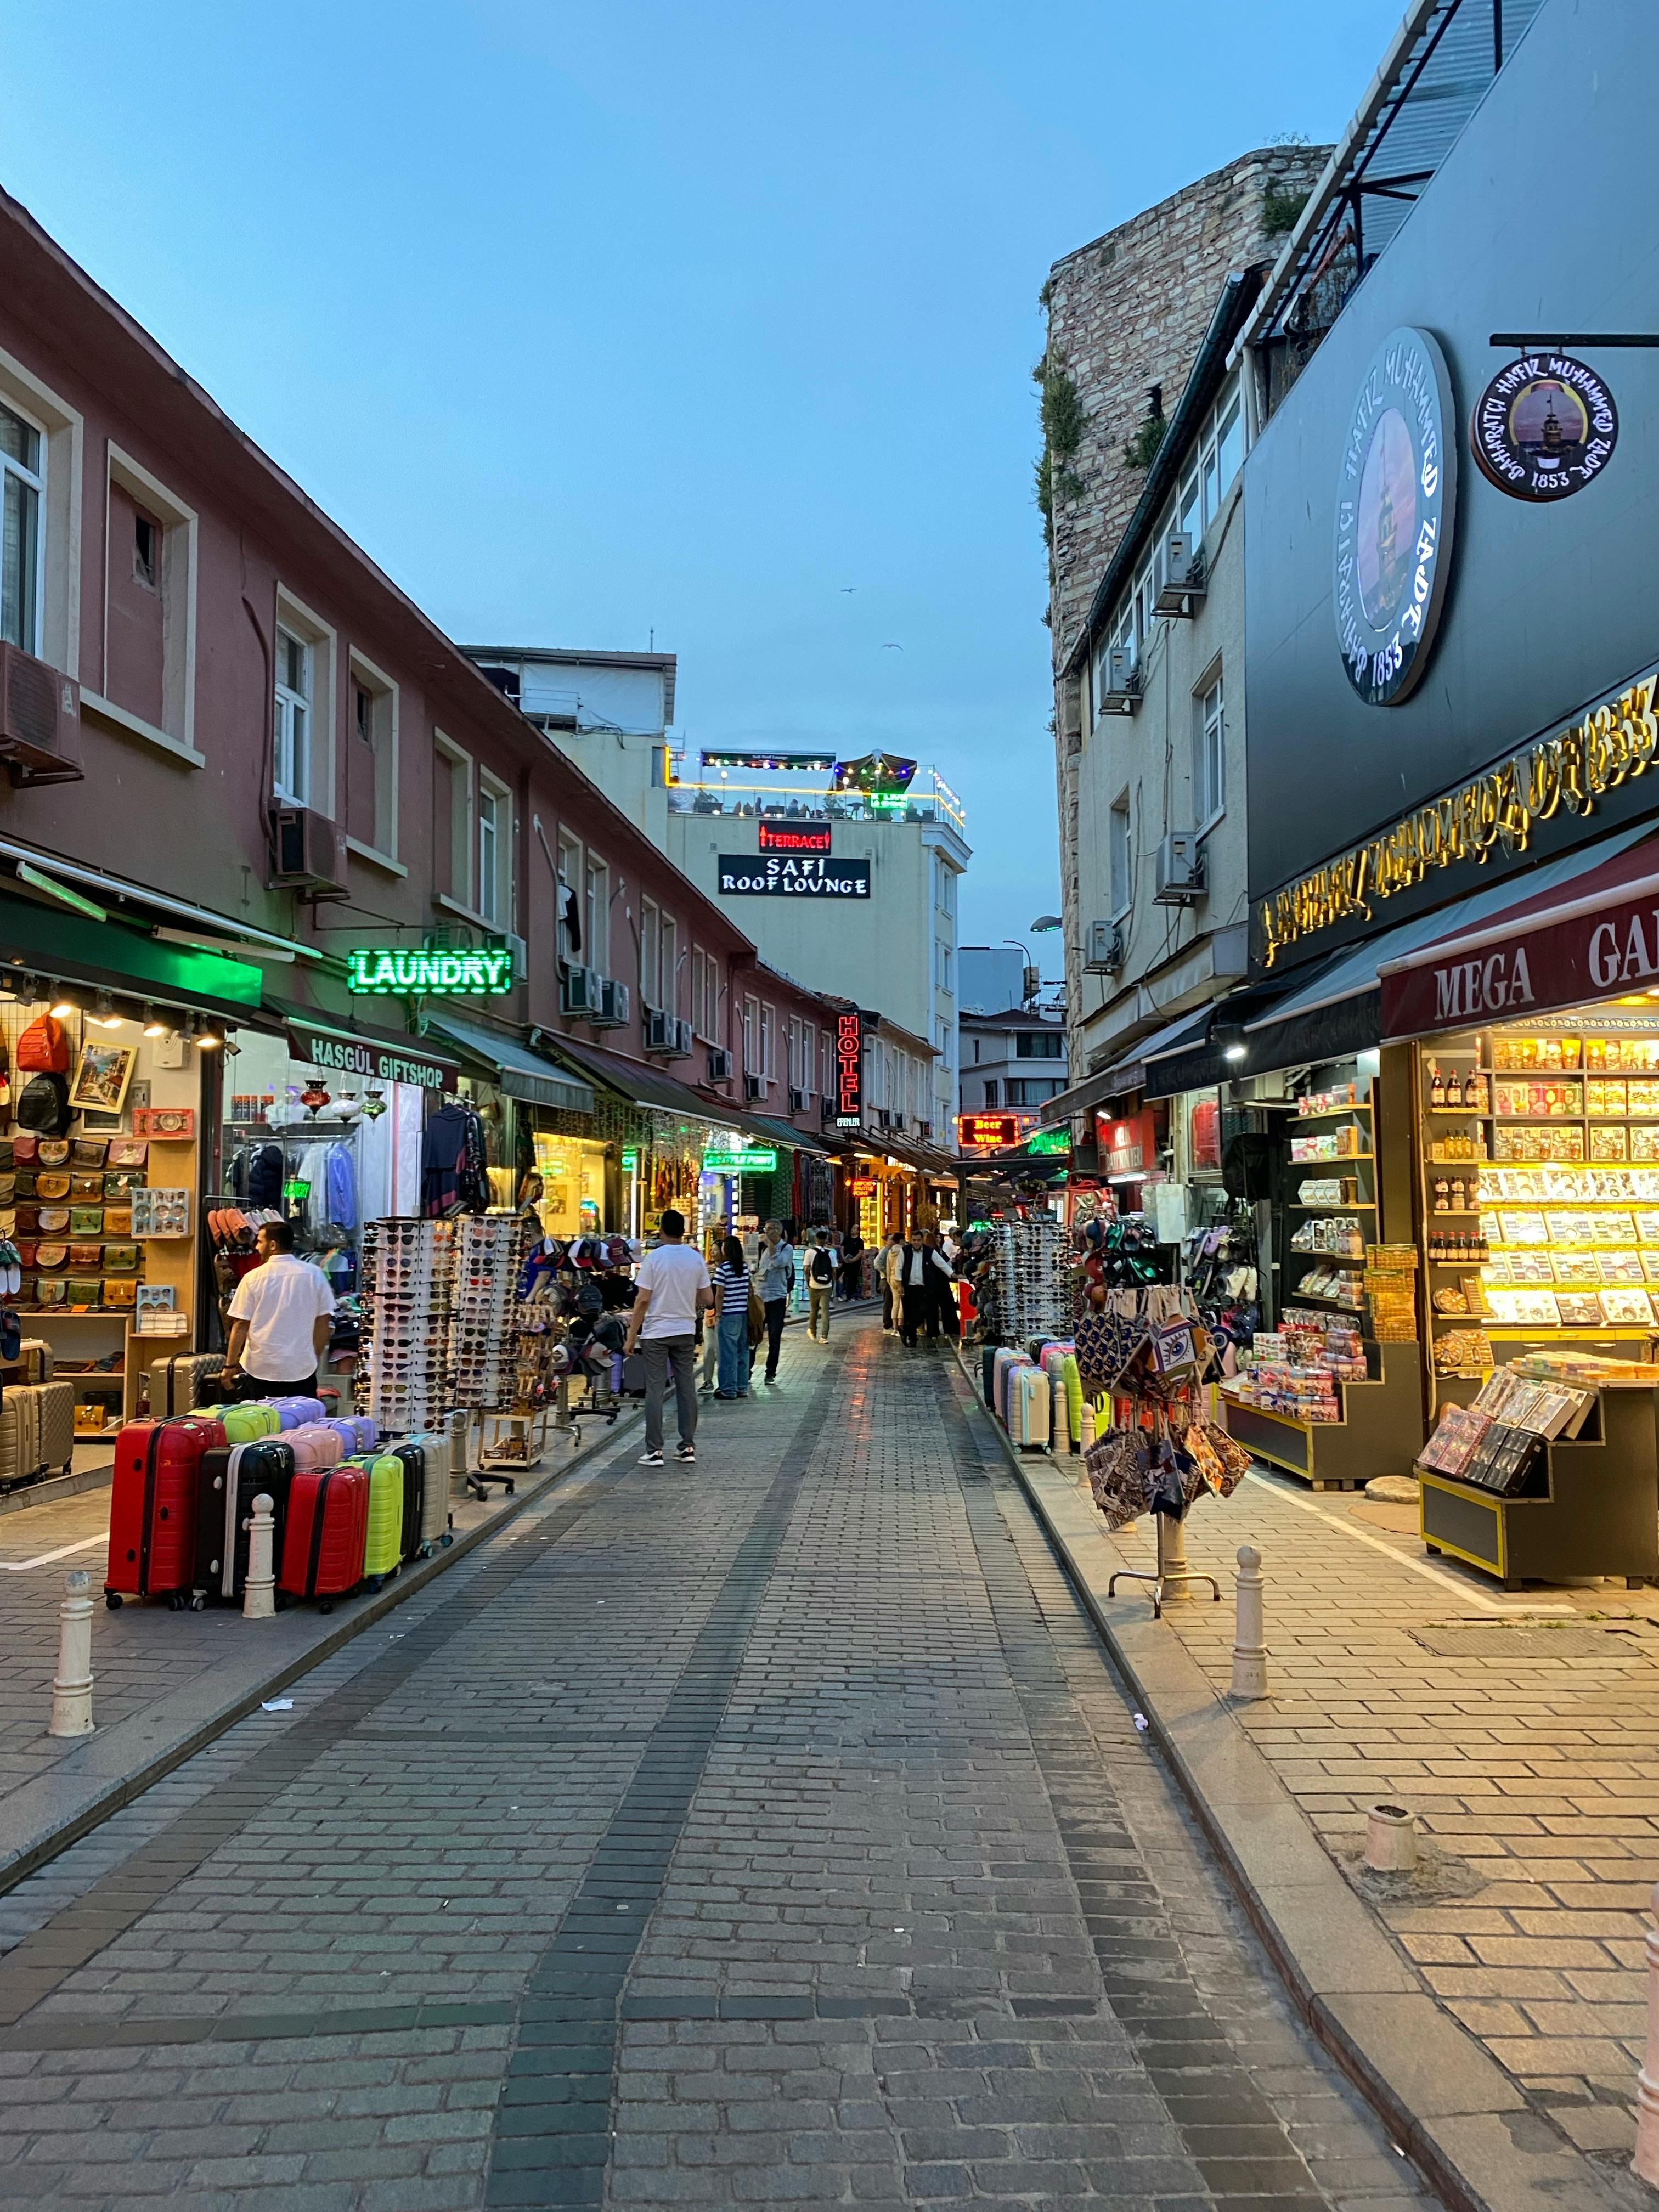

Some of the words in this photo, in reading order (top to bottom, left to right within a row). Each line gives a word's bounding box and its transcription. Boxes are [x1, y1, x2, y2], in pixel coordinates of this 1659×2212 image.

[1495, 358, 1548, 395] HAFIZ
[1549, 358, 1613, 433] MUHAMMED
[1569, 438, 1612, 479] ZADE
[1531, 471, 1570, 488] 1853
[1401, 517, 1436, 637] ZADE
[1373, 631, 1403, 687] 1853
[767, 833, 825, 849] TERRACE
[722, 875, 778, 891] ROOF
[783, 877, 867, 894] LOUNGE
[356, 956, 504, 985] LAUNDRY
[1434, 947, 1535, 1021] MEGA
[312, 1039, 375, 1076] HASGÜL
[379, 1056, 443, 1090] GIFTSHOP
[838, 1016, 859, 1113] HOTEL
[973, 1133, 1003, 1143] Wine
[974, 1119, 1002, 1130] Beer
